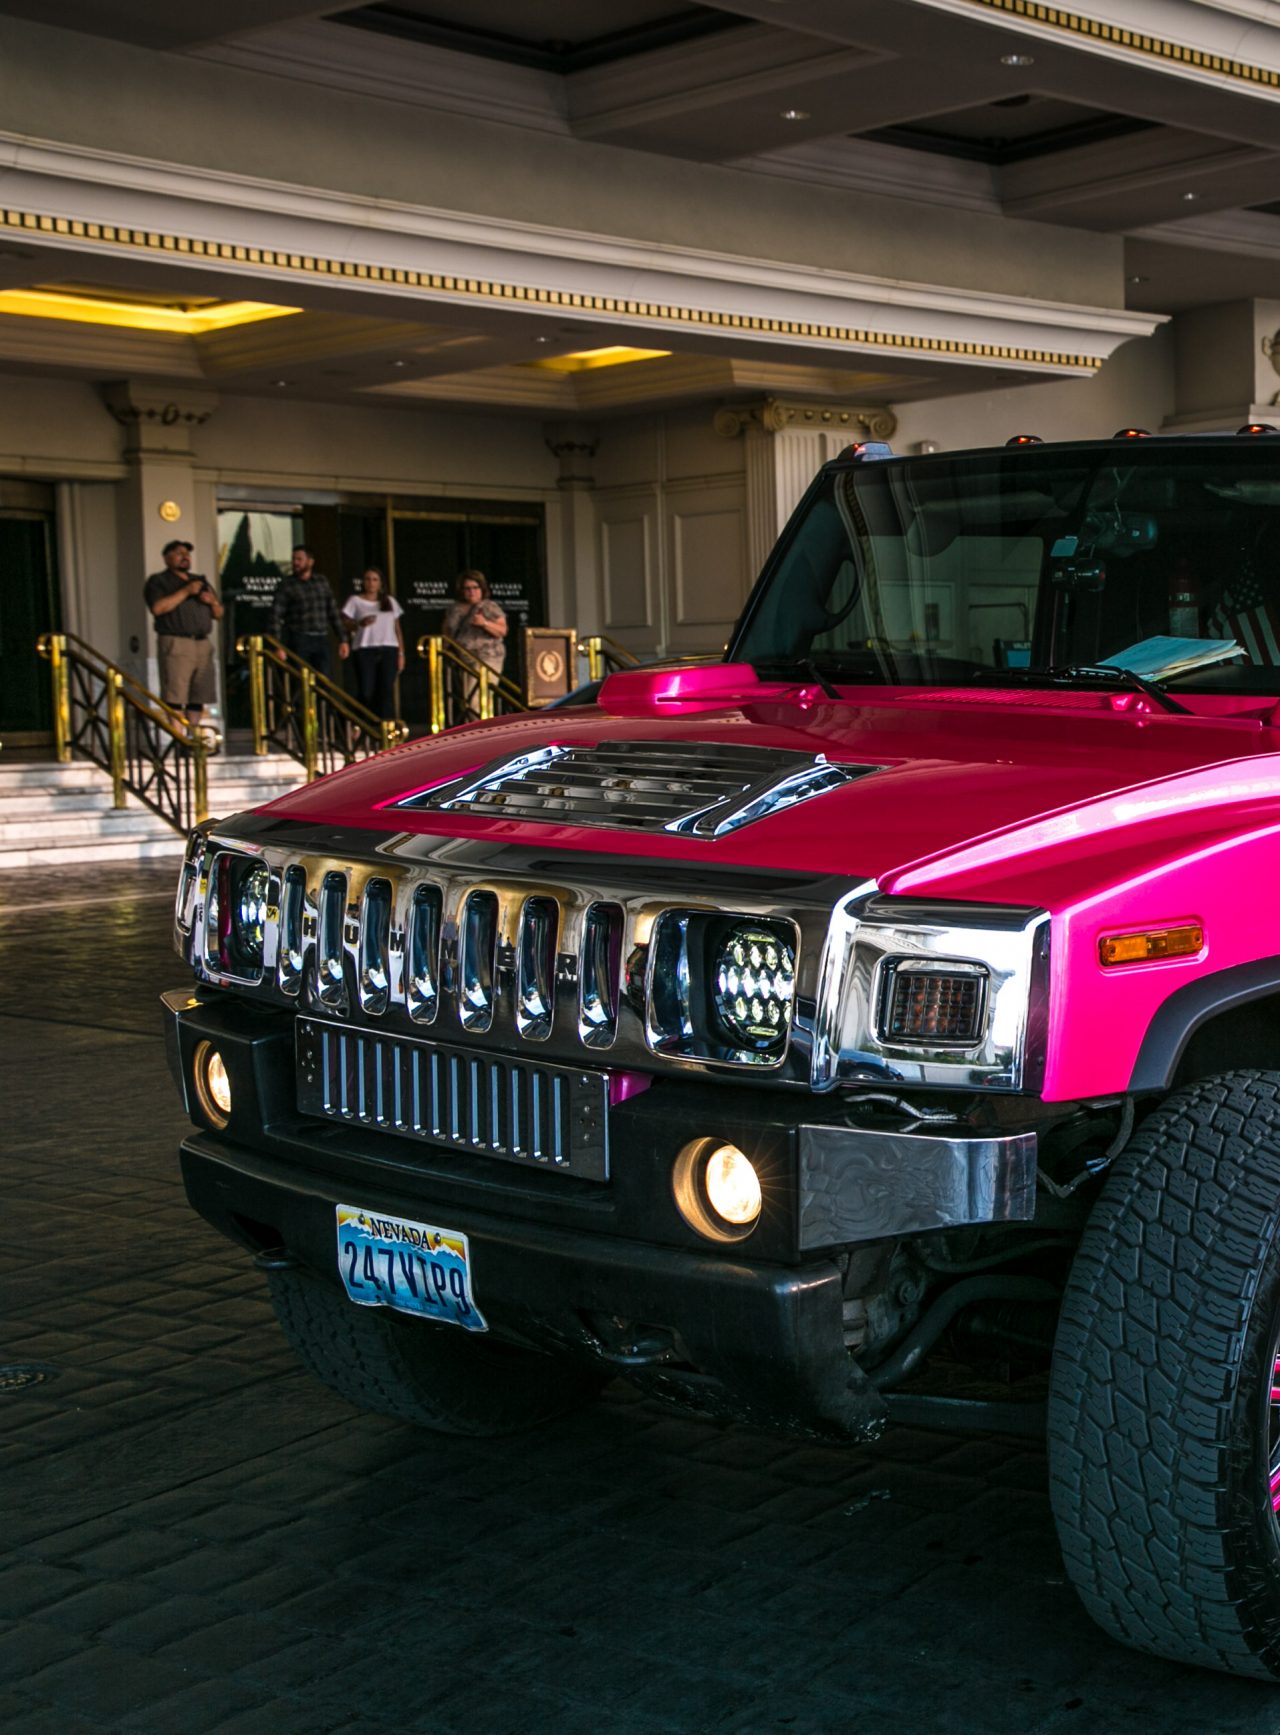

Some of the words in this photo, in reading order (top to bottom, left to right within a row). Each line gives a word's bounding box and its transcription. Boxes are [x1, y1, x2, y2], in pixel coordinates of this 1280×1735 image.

[246, 584, 275, 592] PALAC
[370, 1217, 432, 1251] NEVADA
[344, 1241, 471, 1315] 247VIP9
